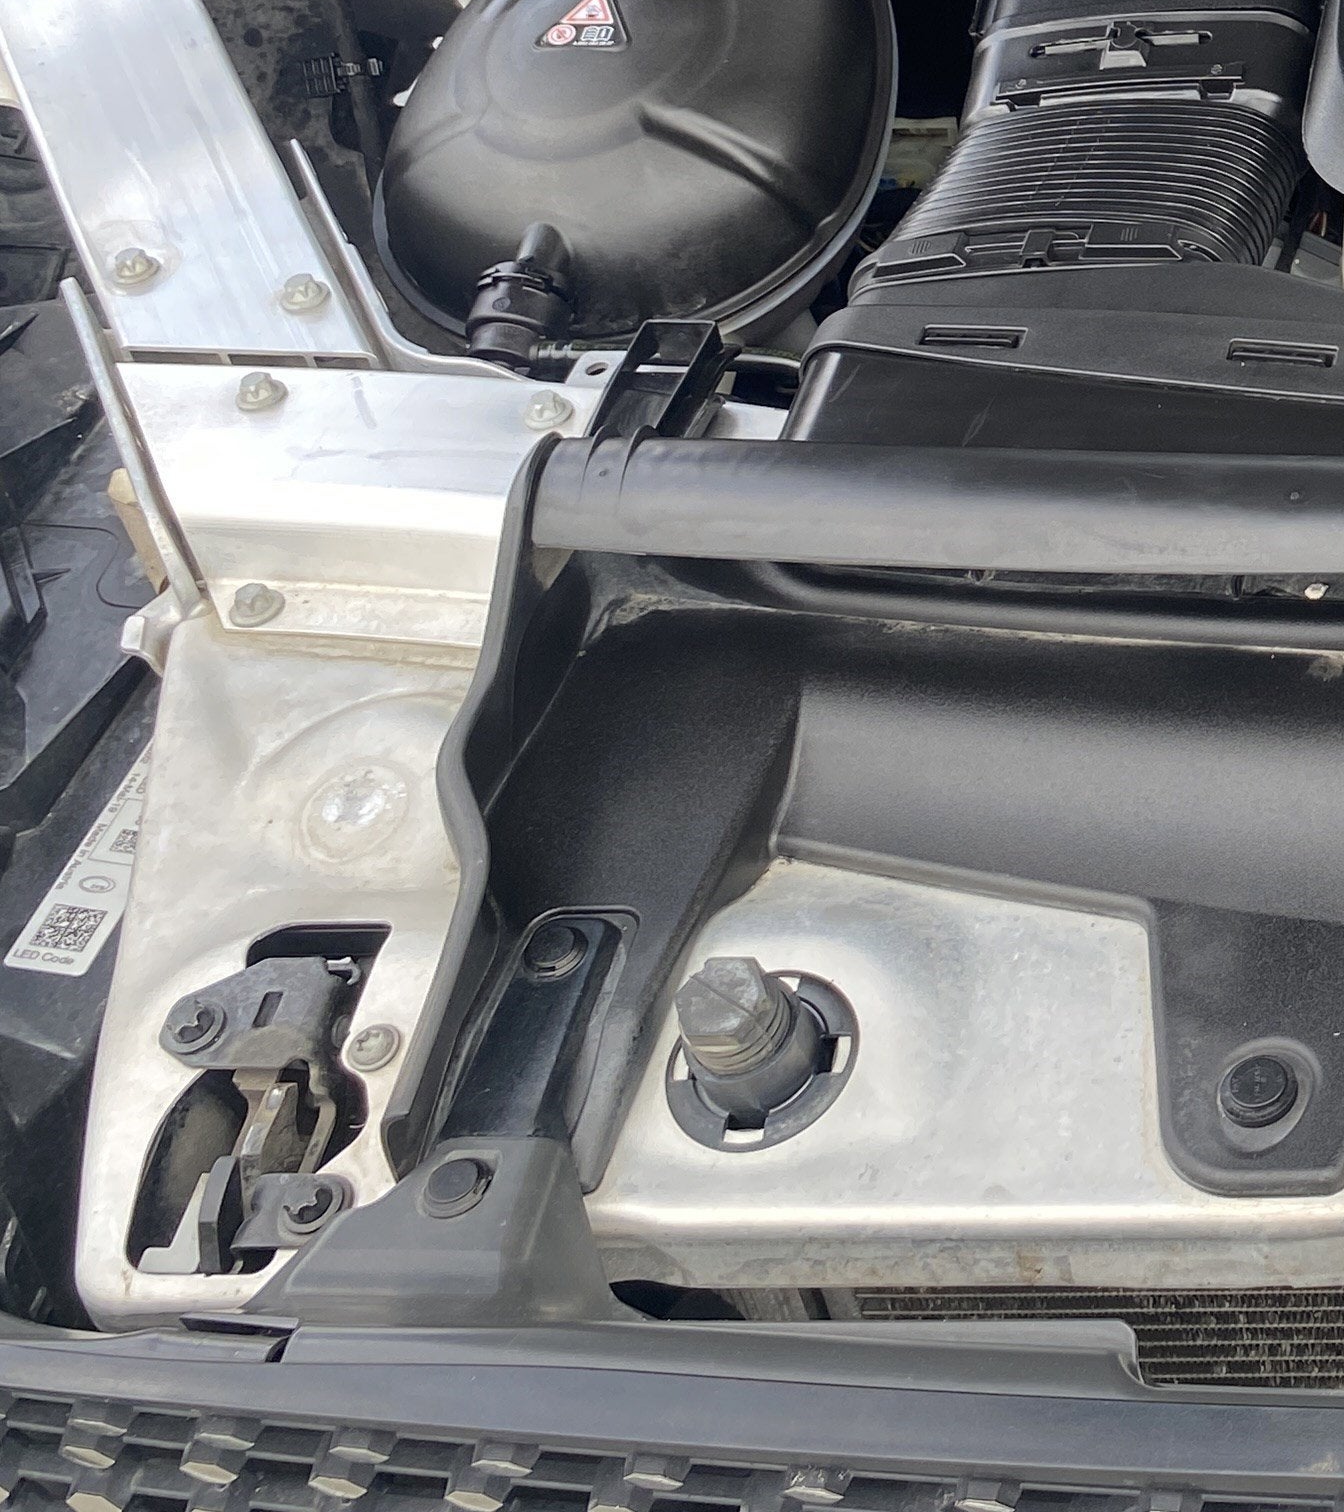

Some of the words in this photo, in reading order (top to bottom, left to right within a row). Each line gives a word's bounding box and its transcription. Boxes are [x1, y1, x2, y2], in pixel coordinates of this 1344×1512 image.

[82, 823, 107, 849] Made
[54, 857, 82, 890] Austria
[13, 948, 40, 961] LED
[41, 951, 75, 965] Code
